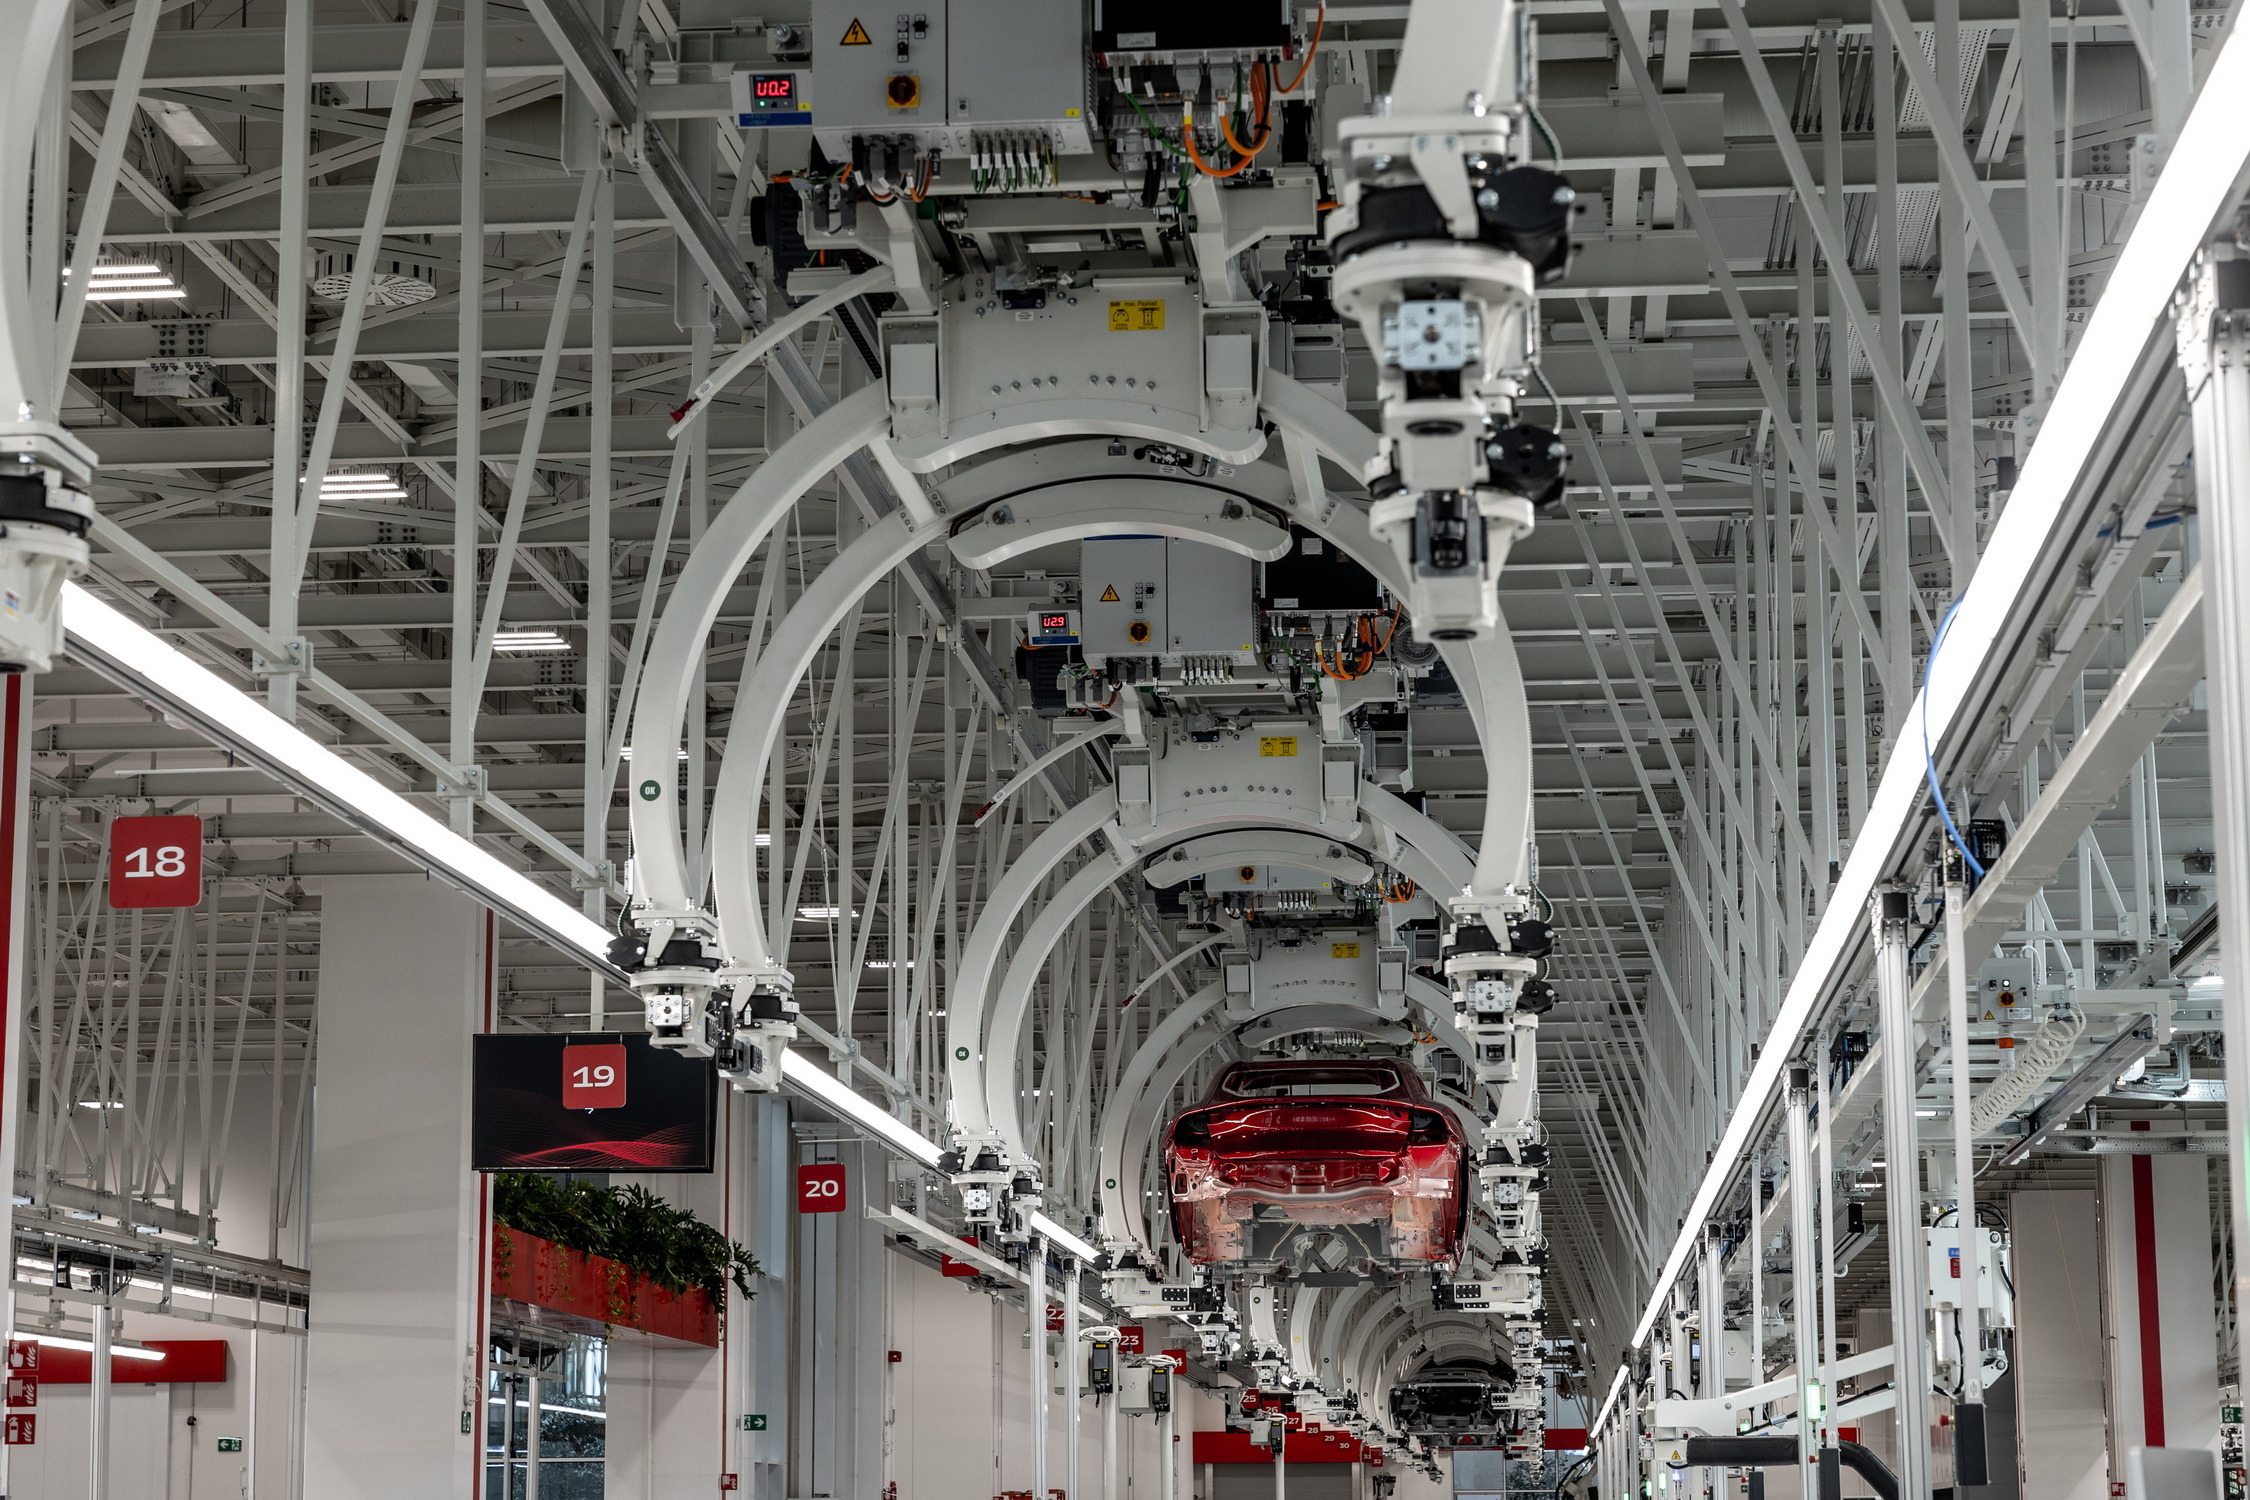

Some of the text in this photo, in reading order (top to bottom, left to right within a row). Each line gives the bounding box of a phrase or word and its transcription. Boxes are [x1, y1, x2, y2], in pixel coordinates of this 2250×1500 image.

[644, 786, 656, 795] OK
[126, 846, 186, 878] 18
[572, 1065, 615, 1088] 19
[805, 1179, 839, 1198] 20
[1120, 1335, 1139, 1346] 23
[1243, 1395, 1257, 1403] 25
[1288, 1417, 1300, 1425] 27
